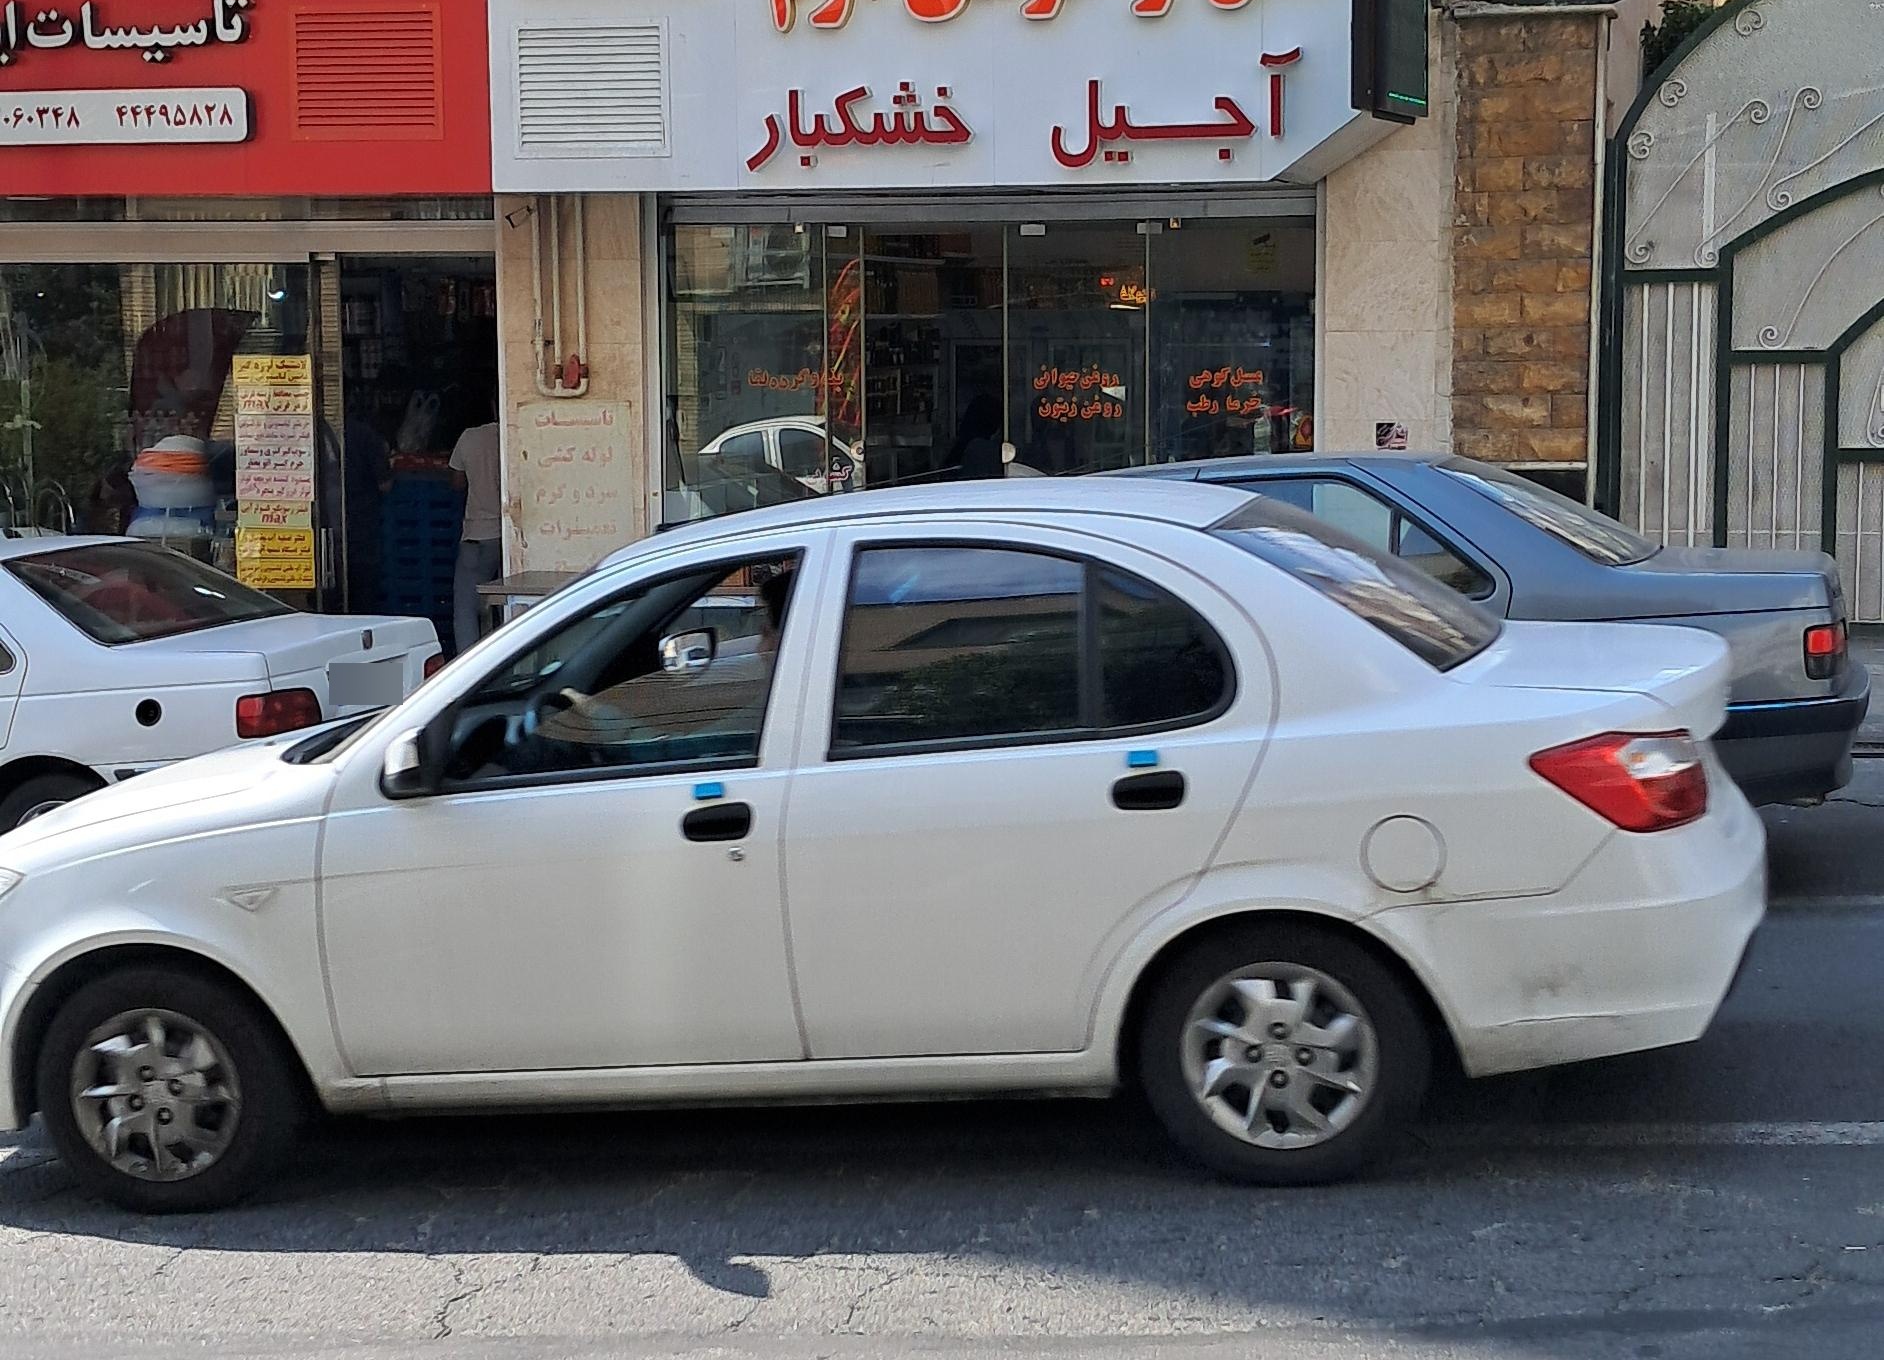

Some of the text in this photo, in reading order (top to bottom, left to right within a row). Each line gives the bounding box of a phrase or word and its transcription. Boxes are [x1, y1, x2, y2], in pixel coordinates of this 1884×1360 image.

[116, 103, 233, 128] ۴۴۴۹۵۸۲۸
[745, 46, 1303, 173] آجیل خشکبار
[1034, 363, 1120, 390] روغن حیوانی
[1189, 367, 1263, 388] عسل کوهی
[1038, 394, 1123, 422] روغن زیتون
[1186, 392, 1262, 417] خرما رطب
[582, 446, 613, 467] لوله
[262, 514, 287, 524] max
